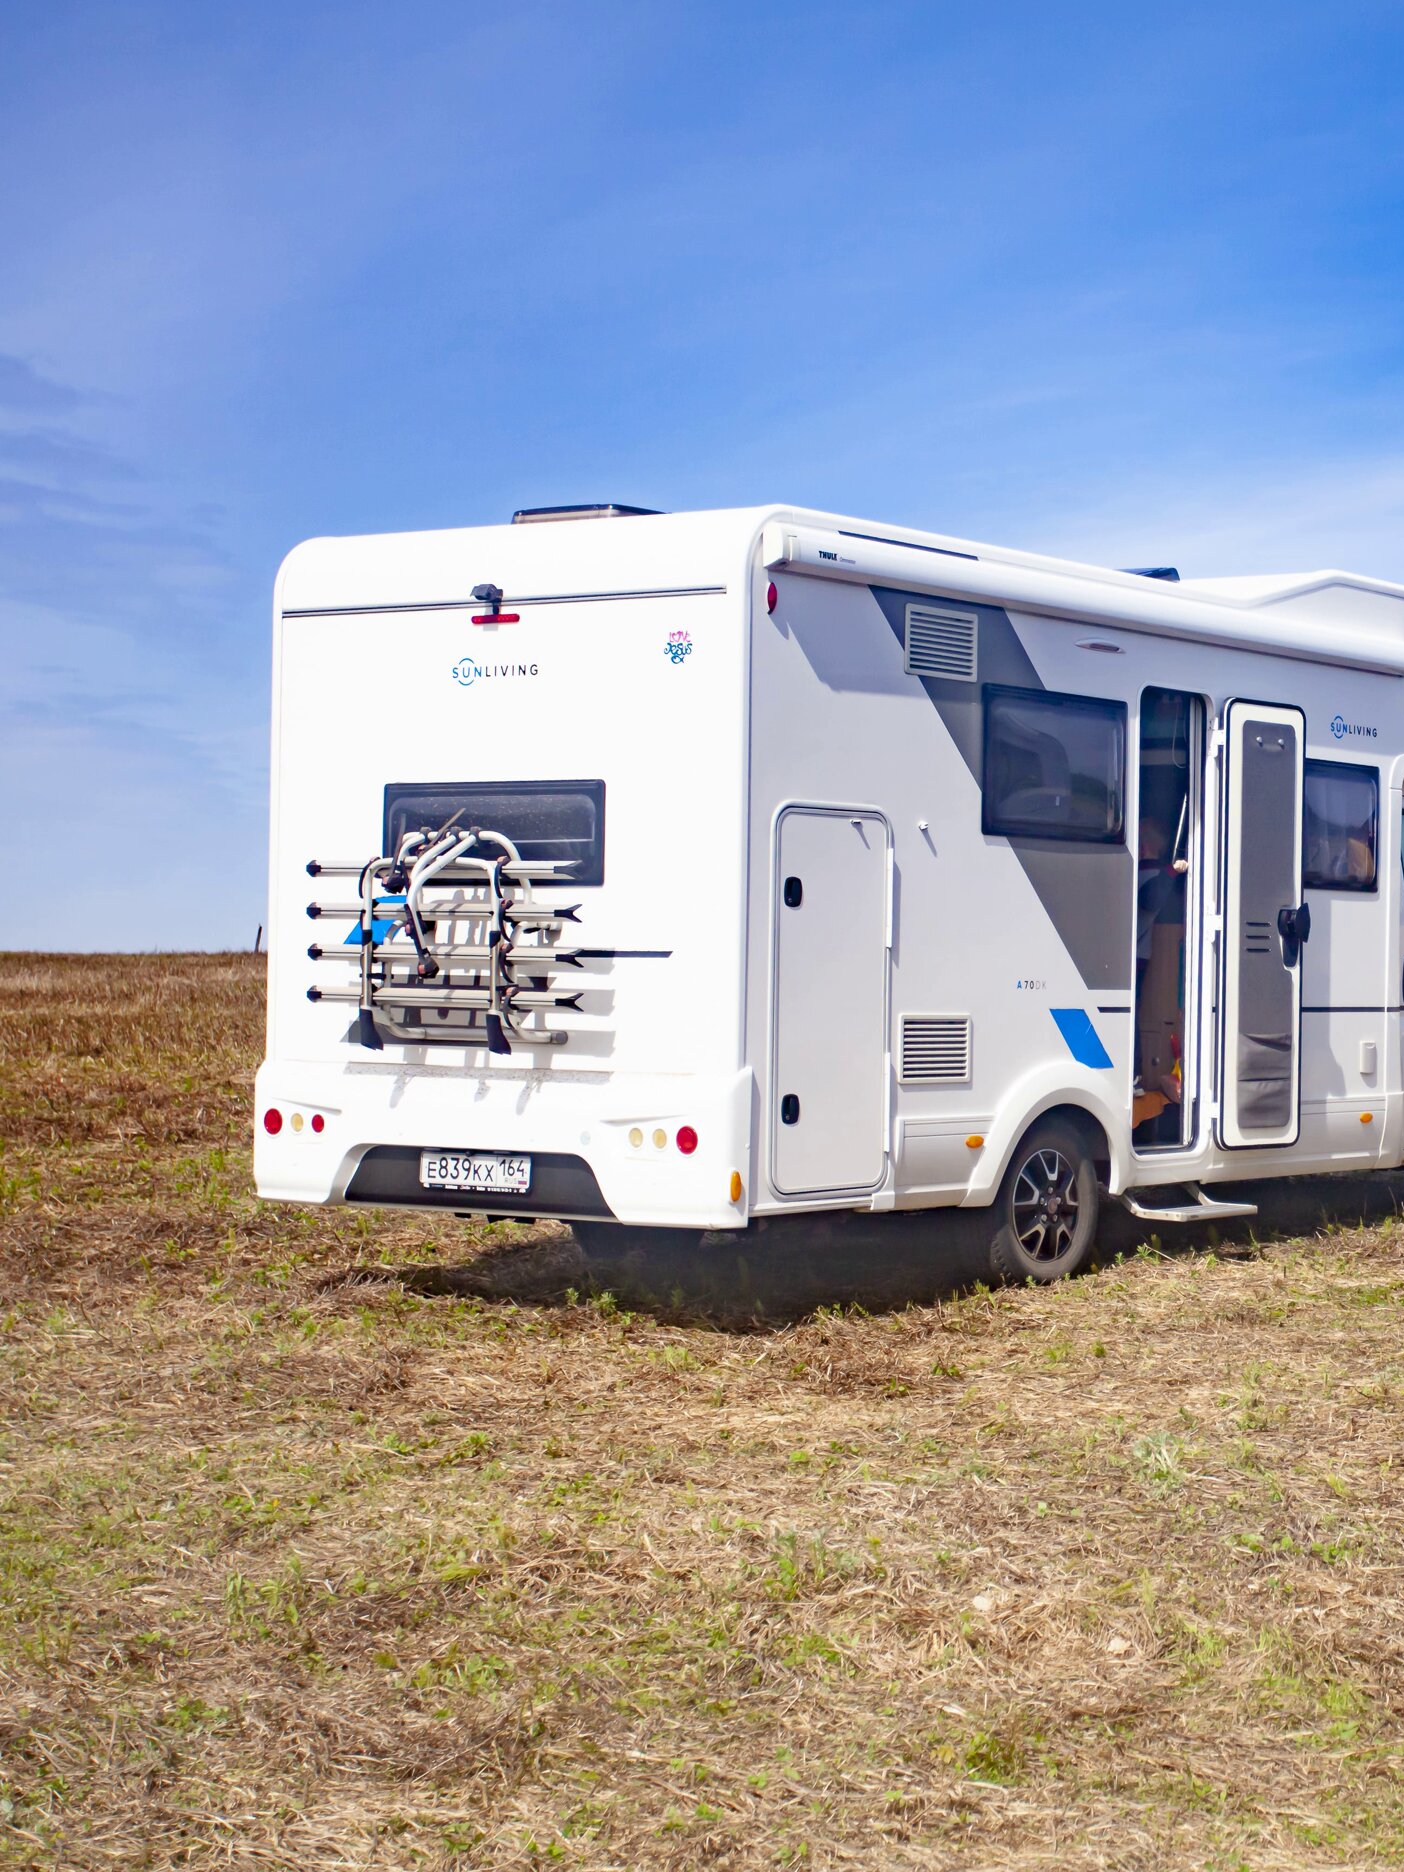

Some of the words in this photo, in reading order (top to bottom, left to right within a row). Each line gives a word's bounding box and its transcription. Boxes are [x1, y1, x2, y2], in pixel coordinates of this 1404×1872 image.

[452, 663, 539, 679] SUNLIVING
[1330, 722, 1378, 738] SUNLIVING
[499, 1159, 525, 1177] 164
